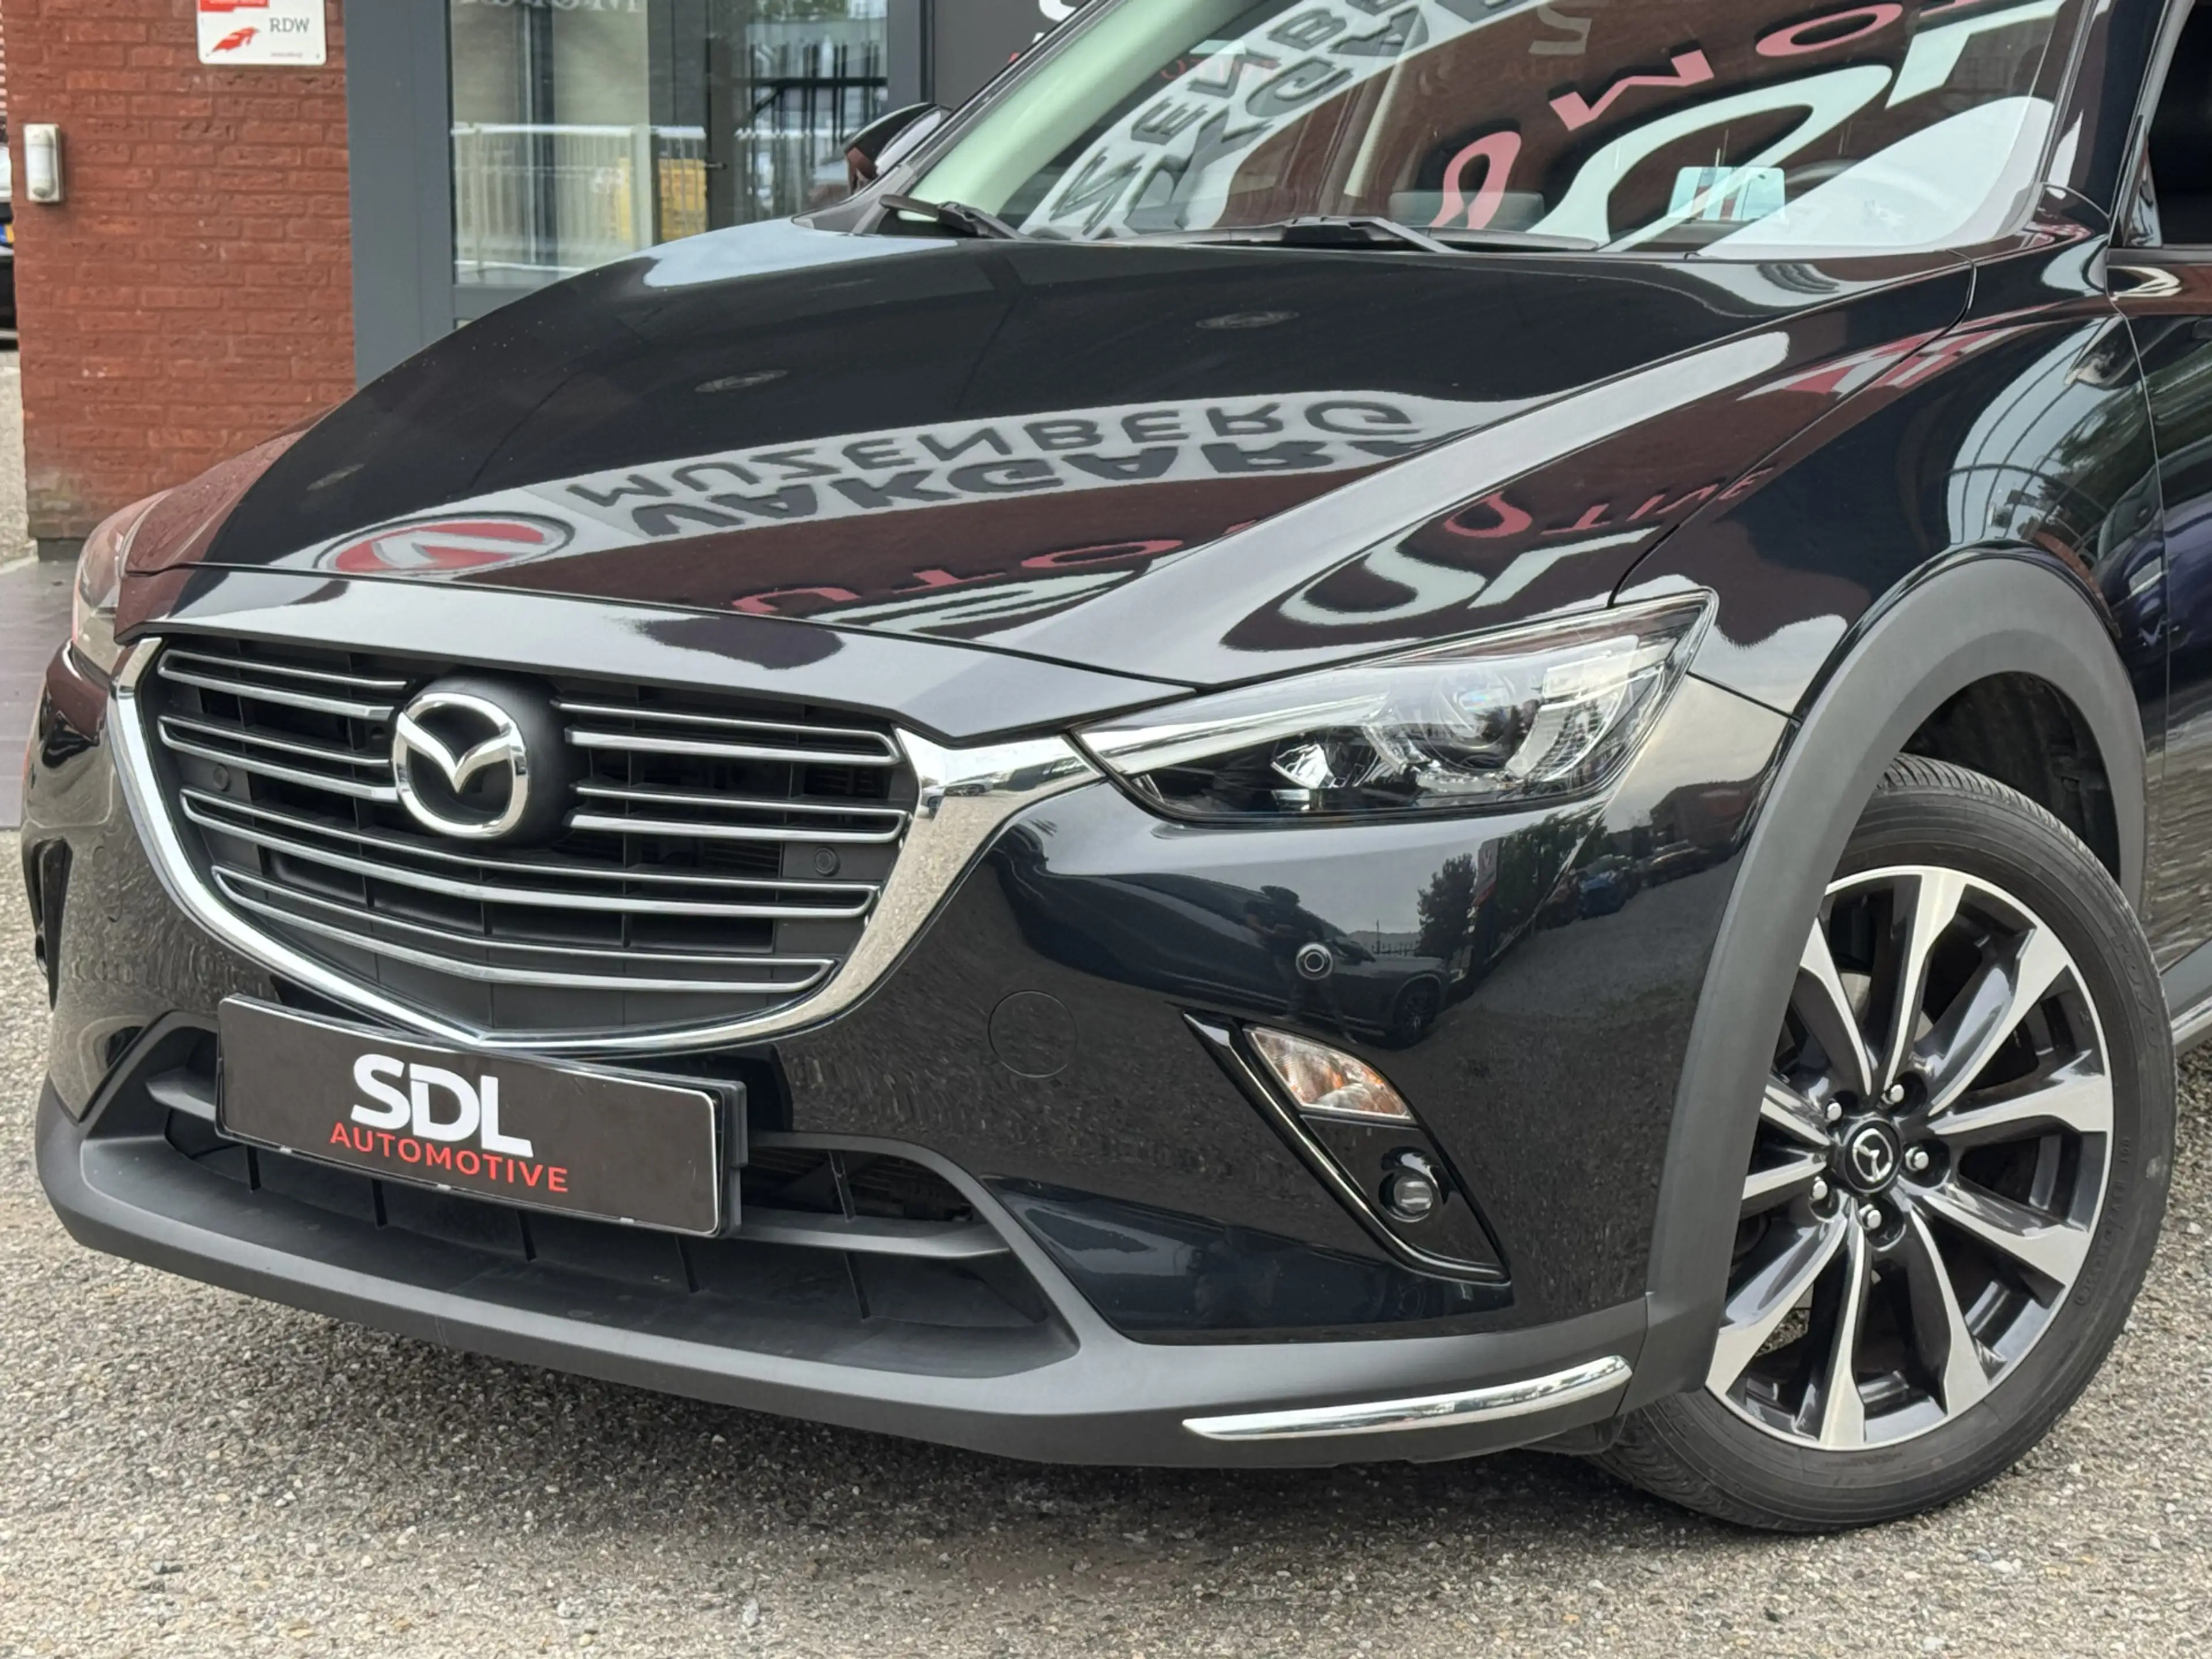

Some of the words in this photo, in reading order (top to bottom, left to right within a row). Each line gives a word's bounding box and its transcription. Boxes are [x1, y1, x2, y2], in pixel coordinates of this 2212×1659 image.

[268, 17, 310, 33] RDW
[350, 1054, 534, 1158] SDL
[330, 1123, 569, 1192] AUTOMOTIVE
